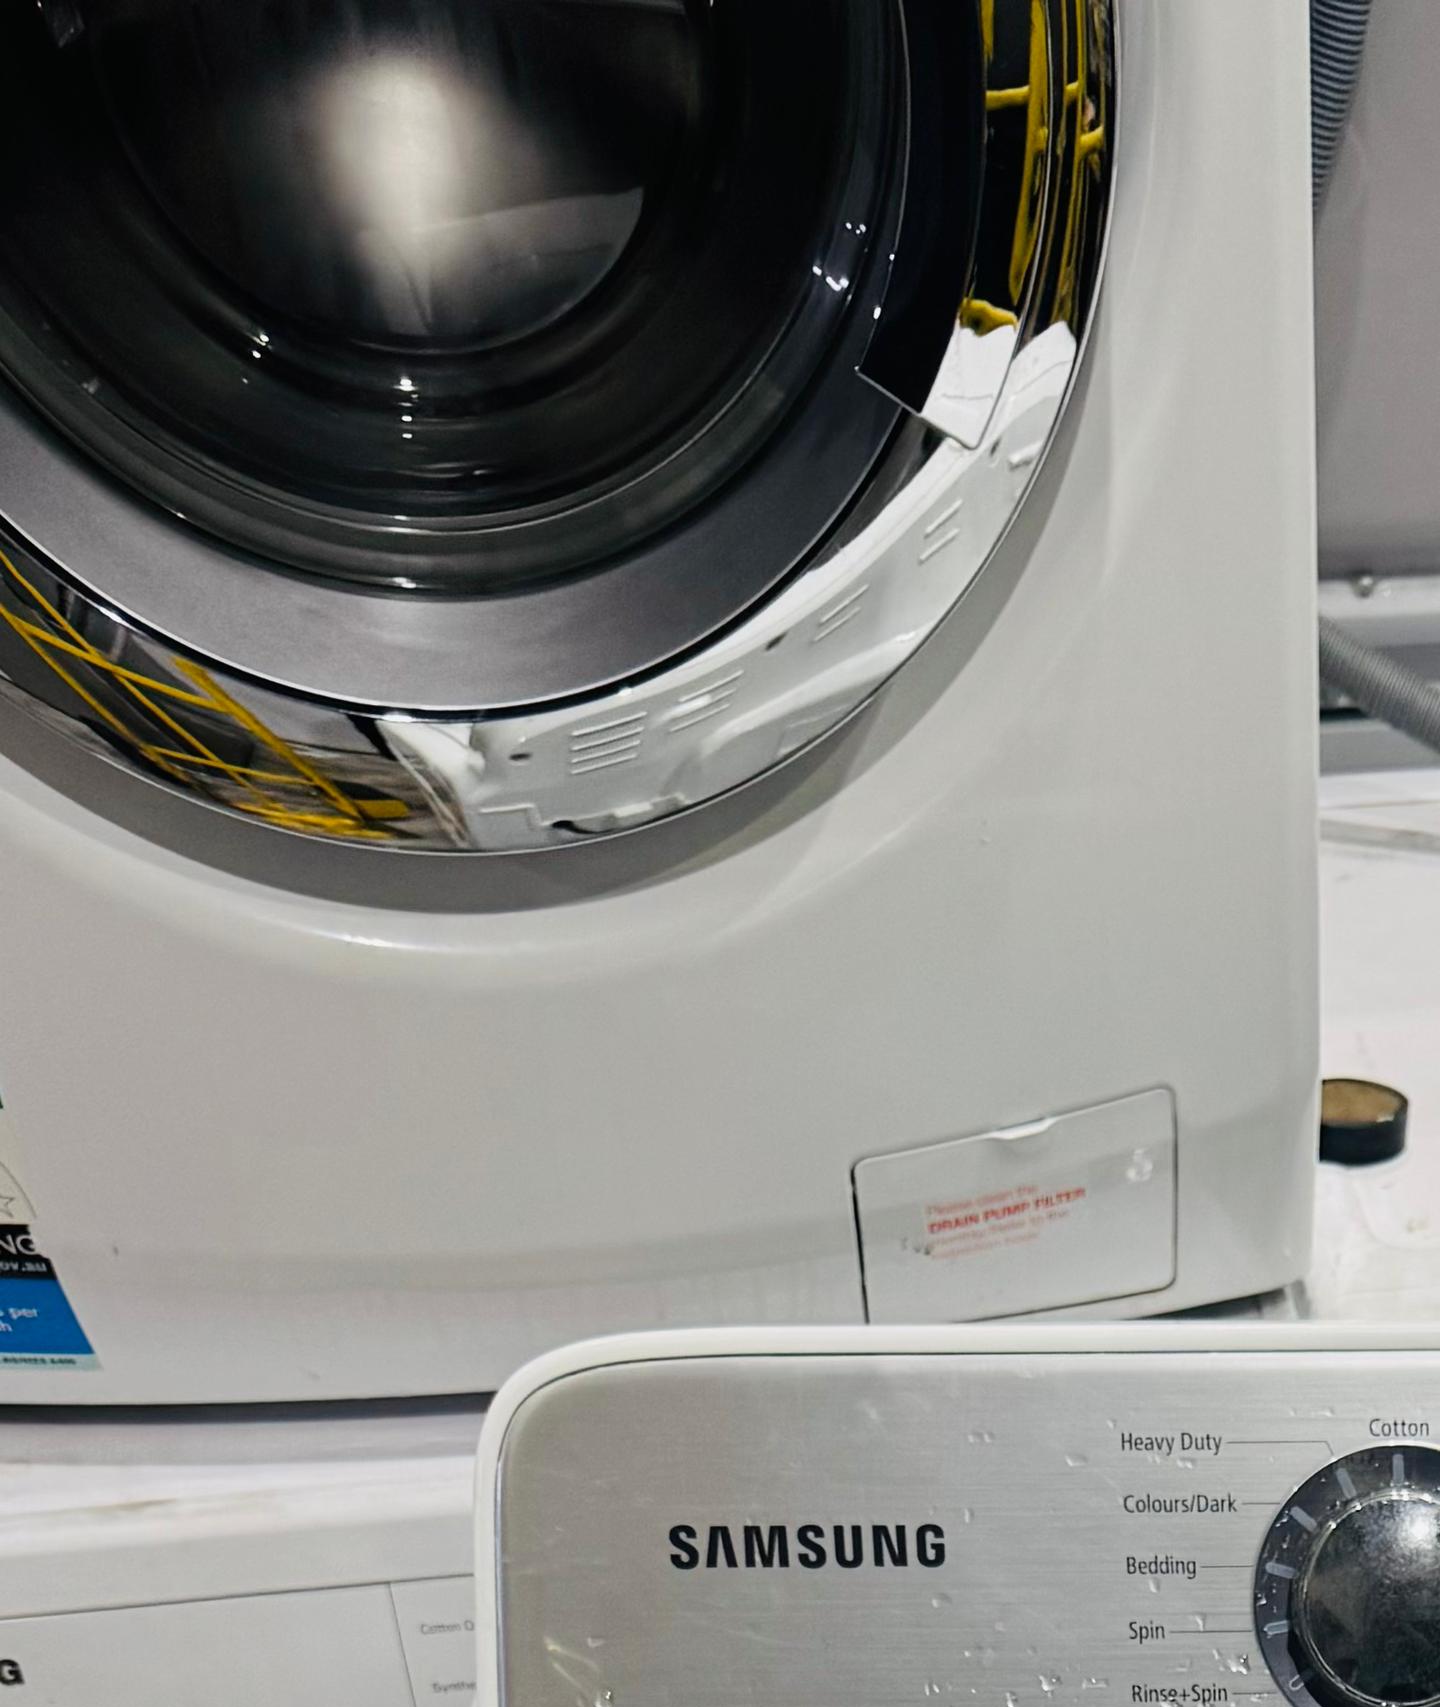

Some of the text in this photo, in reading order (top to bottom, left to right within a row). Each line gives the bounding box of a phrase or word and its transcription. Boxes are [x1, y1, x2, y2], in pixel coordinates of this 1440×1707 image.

[928, 1186, 1087, 1234] DRAIN PUMP FILTER
[1369, 1418, 1430, 1437] Cotton
[1121, 1433, 1222, 1456] Heavy Duty
[1122, 1495, 1238, 1514] Colours/Dark
[668, 1523, 947, 1571] SAMSUNG
[1126, 1556, 1197, 1579] Bedding
[1129, 1621, 1166, 1643] Spin
[1132, 1684, 1228, 1704] Rinse+Spin
